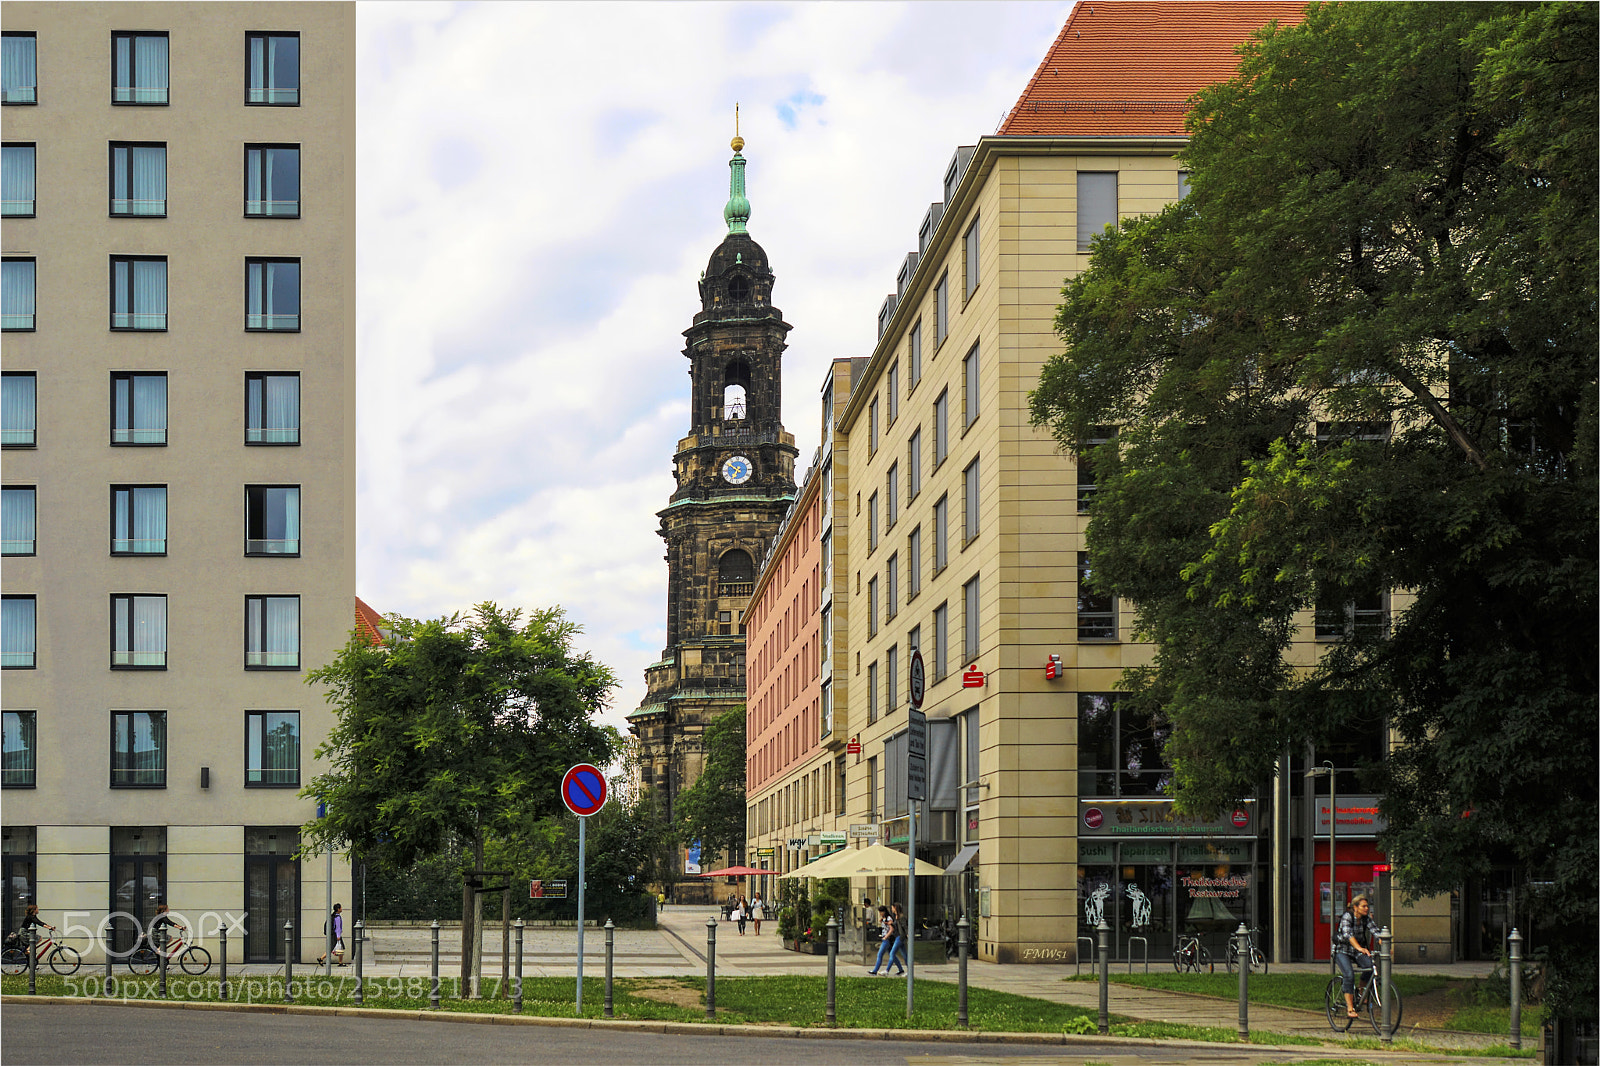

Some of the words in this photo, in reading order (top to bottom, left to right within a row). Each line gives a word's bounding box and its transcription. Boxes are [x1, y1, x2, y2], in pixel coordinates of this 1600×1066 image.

[1335, 817, 1373, 825] Immobilien
[1111, 825, 1175, 833] Thailändisches
[1177, 825, 1224, 833] Restaurant
[1080, 845, 1107, 856] Sushi
[1188, 888, 1240, 898] Restaurant
